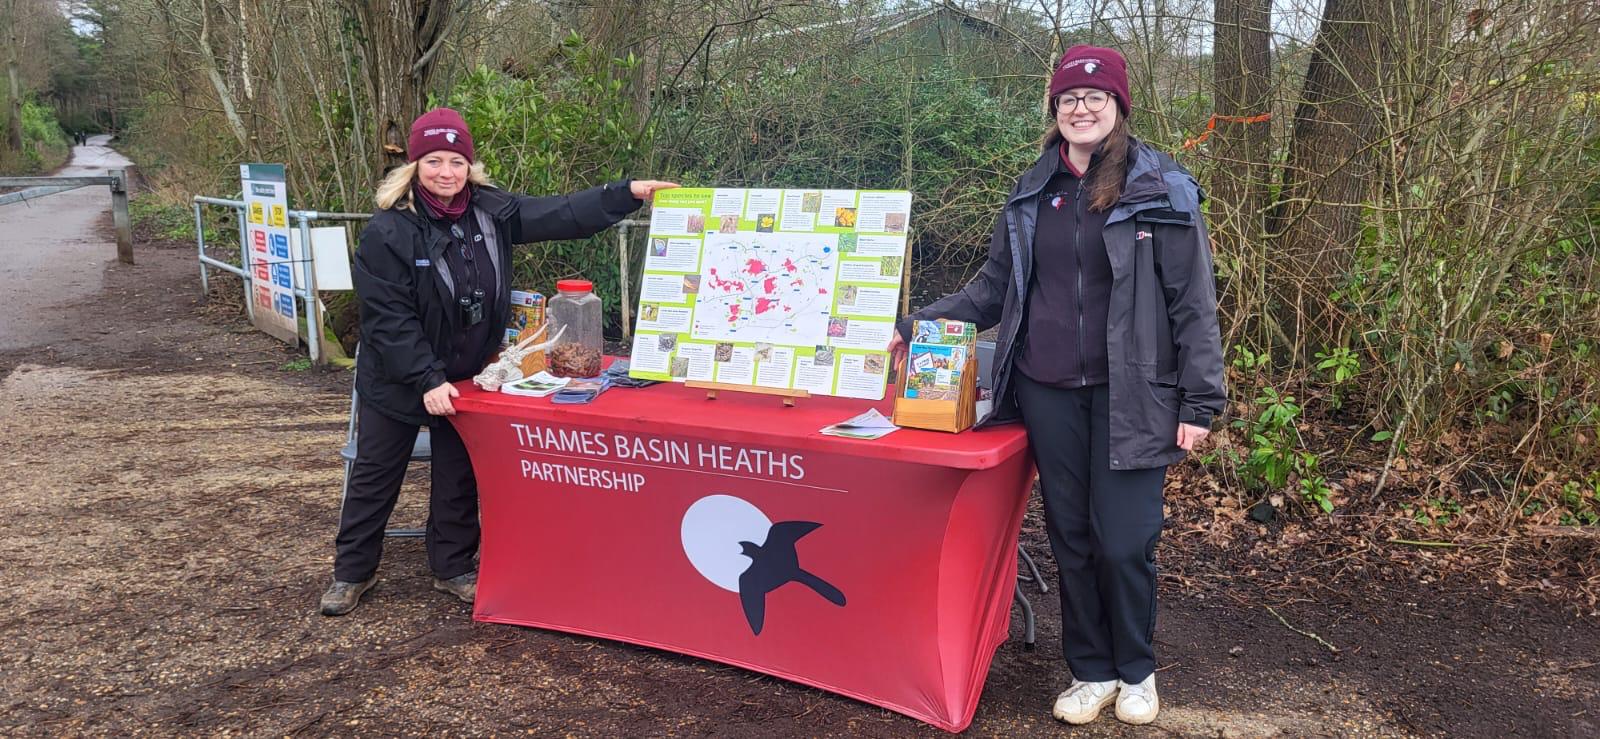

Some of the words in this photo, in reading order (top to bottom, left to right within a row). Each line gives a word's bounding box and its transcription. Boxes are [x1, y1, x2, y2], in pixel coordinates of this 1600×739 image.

[510, 423, 609, 456] THAMES
[614, 434, 690, 465] BASIN
[697, 443, 805, 480] HEATHS
[520, 459, 645, 493] PARTNERSHIP
